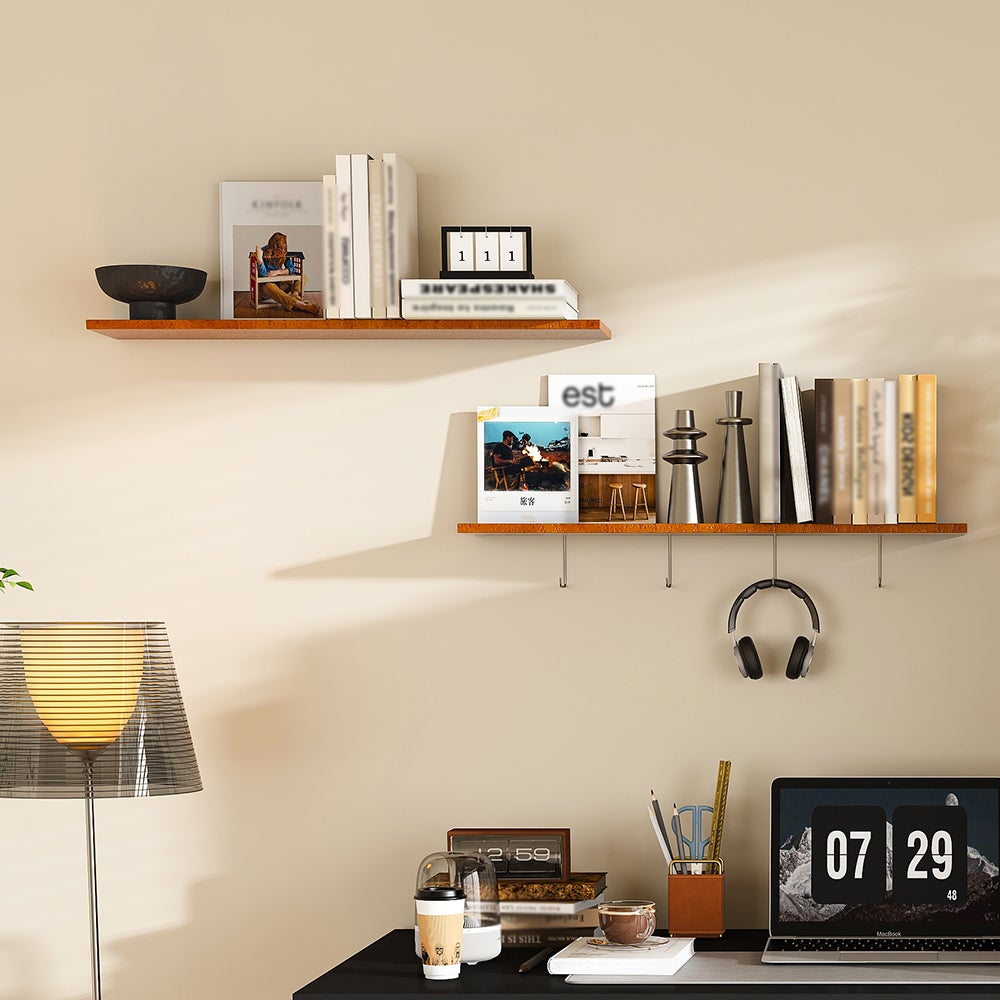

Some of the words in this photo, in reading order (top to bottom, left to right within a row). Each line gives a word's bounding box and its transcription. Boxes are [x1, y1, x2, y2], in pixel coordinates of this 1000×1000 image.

[459, 250, 465, 261] 1
[484, 250, 490, 261] 1
[509, 250, 515, 261] 1
[421, 284, 556, 295] SHAKESPEARE
[562, 382, 615, 408] est
[514, 847, 550, 862] 59
[826, 830, 872, 880] 07
[906, 830, 953, 880] 29
[946, 889, 958, 901] 48
[519, 934, 541, 944] THIS
